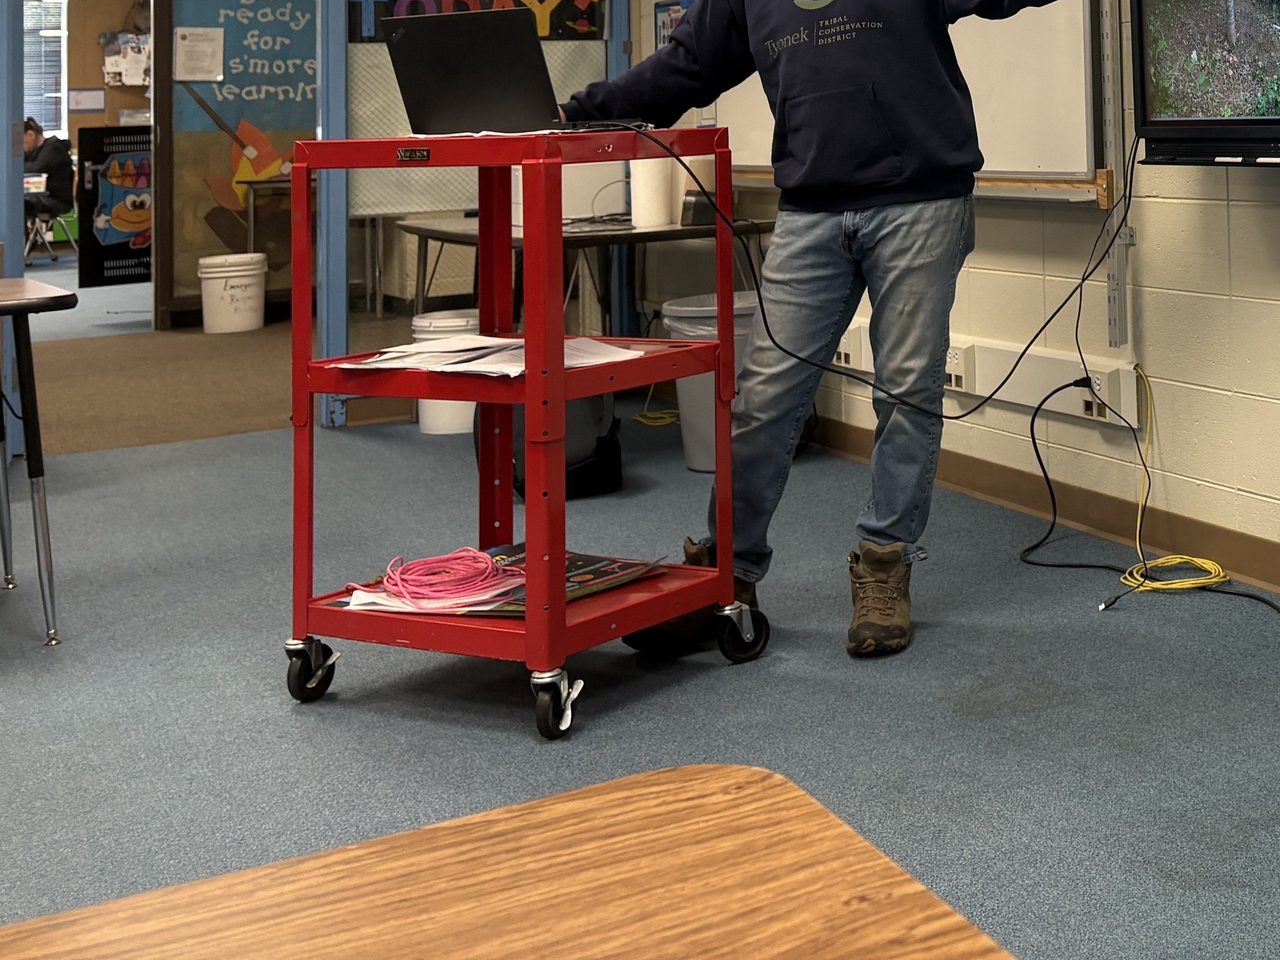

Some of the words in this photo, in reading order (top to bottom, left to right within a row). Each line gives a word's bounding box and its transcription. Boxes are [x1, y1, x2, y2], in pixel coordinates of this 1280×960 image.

[218, 3, 311, 30] ready
[819, 15, 848, 27] TRIBAL
[818, 22, 883, 36] CONSERVATION
[242, 29, 291, 51] for
[764, 26, 809, 58] Tyonek
[818, 32, 857, 45] DISTRICT
